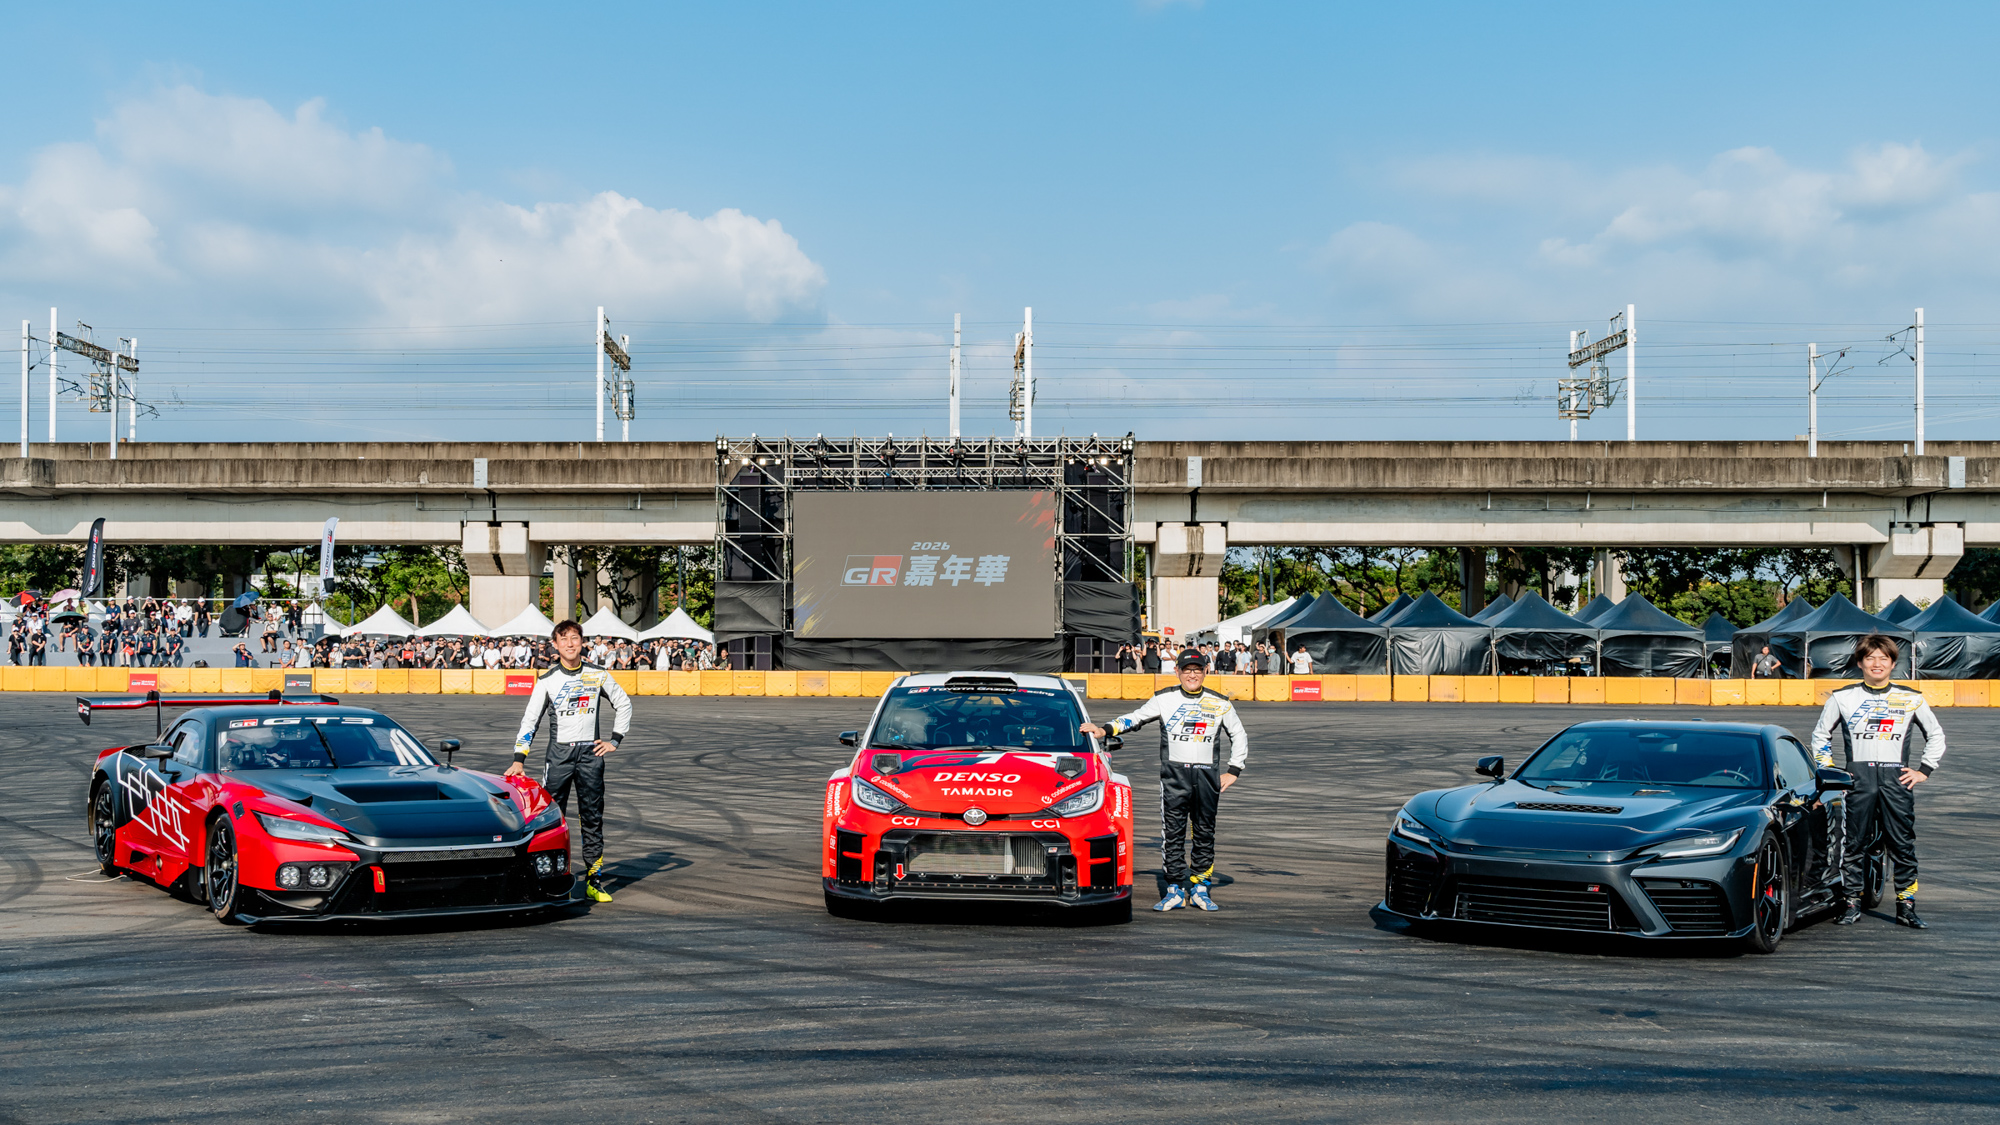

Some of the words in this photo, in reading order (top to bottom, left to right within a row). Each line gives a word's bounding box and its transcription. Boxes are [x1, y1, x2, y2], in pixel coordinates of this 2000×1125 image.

[911, 541, 950, 551] 2026
[844, 567, 897, 584] GR
[903, 554, 1011, 587] 嘉年華
[1018, 688, 1055, 696] Racing
[262, 717, 374, 725] GT3
[933, 772, 1021, 783] DENSO
[941, 787, 1013, 797] TAMADIC
[826, 783, 835, 818] AUTOMOTIVE
[834, 781, 844, 816] Panasonic
[891, 816, 920, 827] CCI
[1031, 820, 1060, 829] CCI
